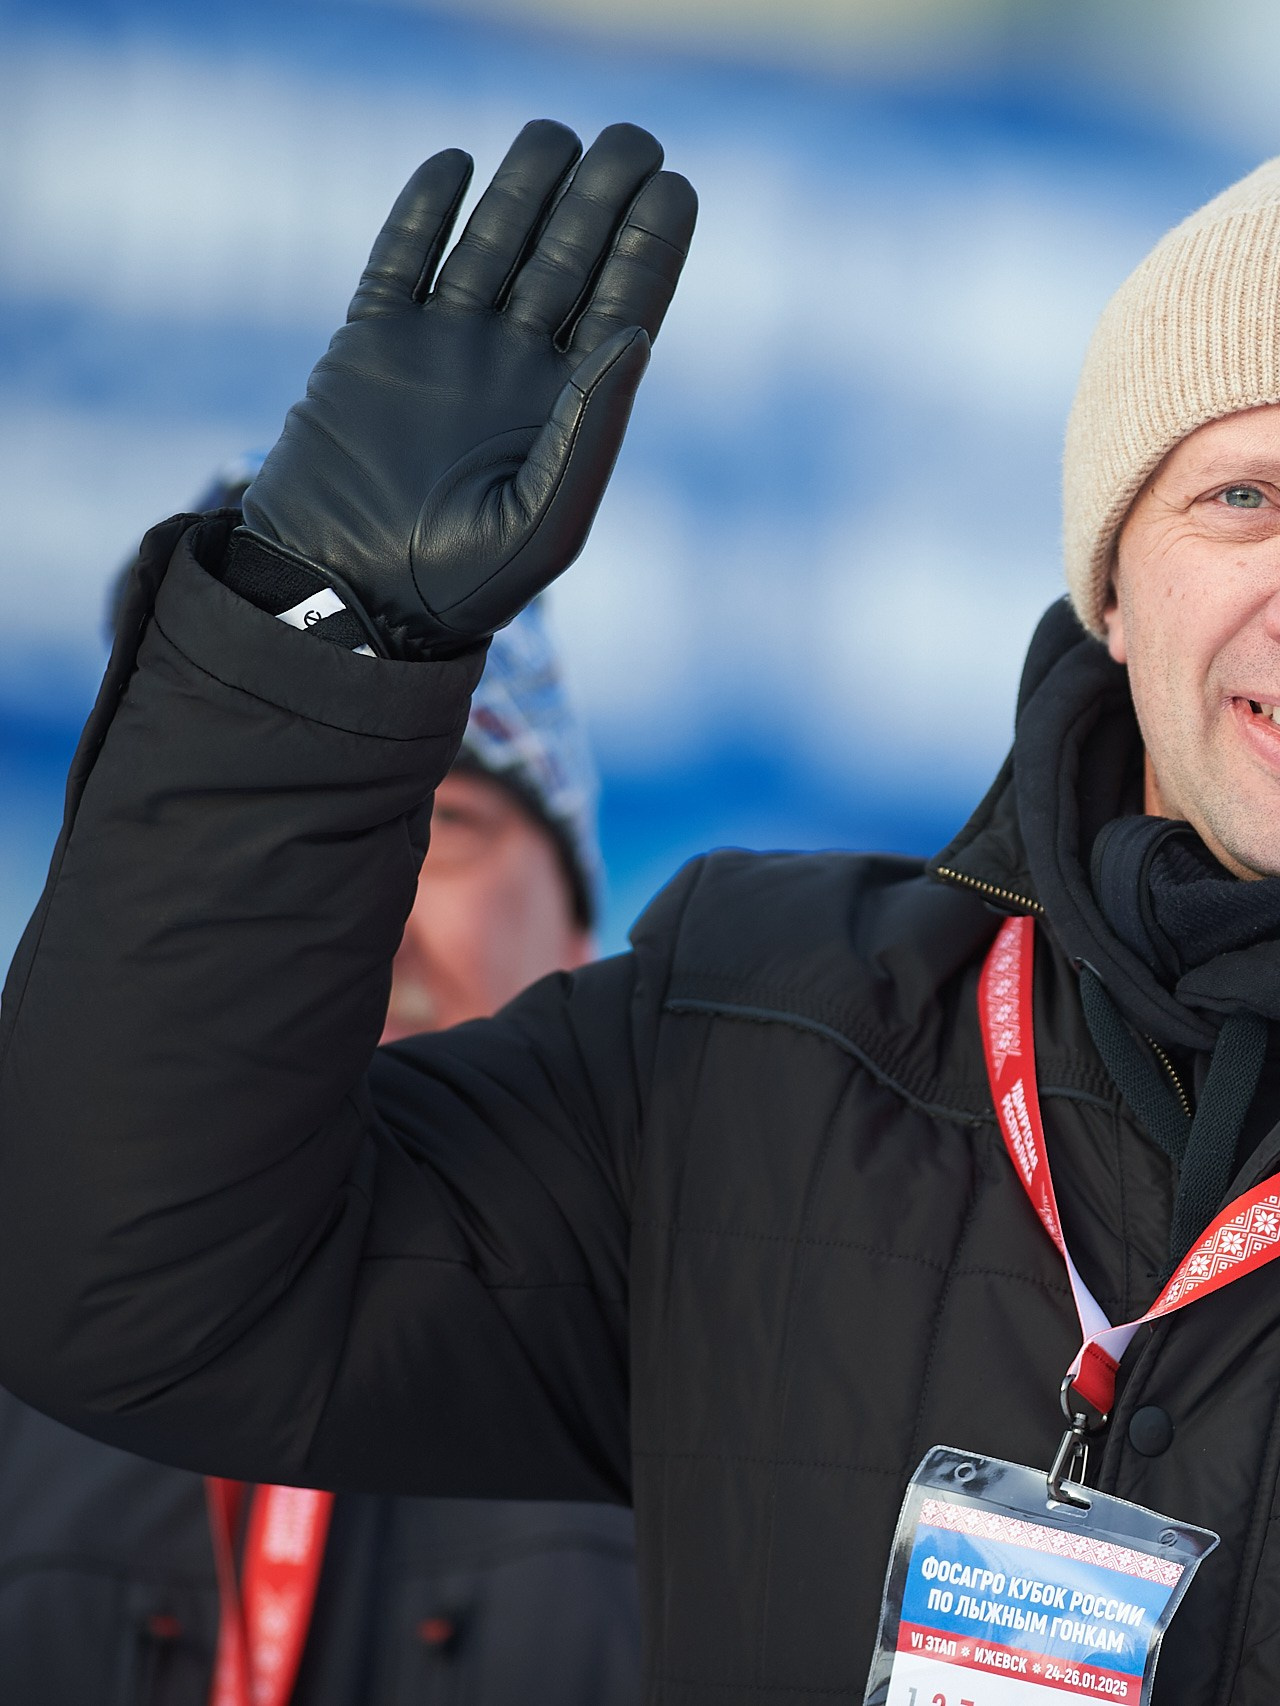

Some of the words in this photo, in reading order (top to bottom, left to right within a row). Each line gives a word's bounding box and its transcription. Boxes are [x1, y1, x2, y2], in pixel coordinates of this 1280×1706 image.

[921, 1556, 1006, 1594] ФОСАГРО
[1007, 1577, 1068, 1610] КУБОК
[1070, 1590, 1146, 1627] РОССИИ
[928, 1588, 952, 1615] ПО
[954, 1596, 1047, 1633] ЛЫЖНЫМ
[1050, 1617, 1125, 1654] ГОНКАМ
[911, 1631, 923, 1649] VI
[924, 1635, 957, 1657] ЭТАП
[974, 1647, 1028, 1673] ИЖЕВСК
[1044, 1663, 1128, 1697] 24-26.01.2025
